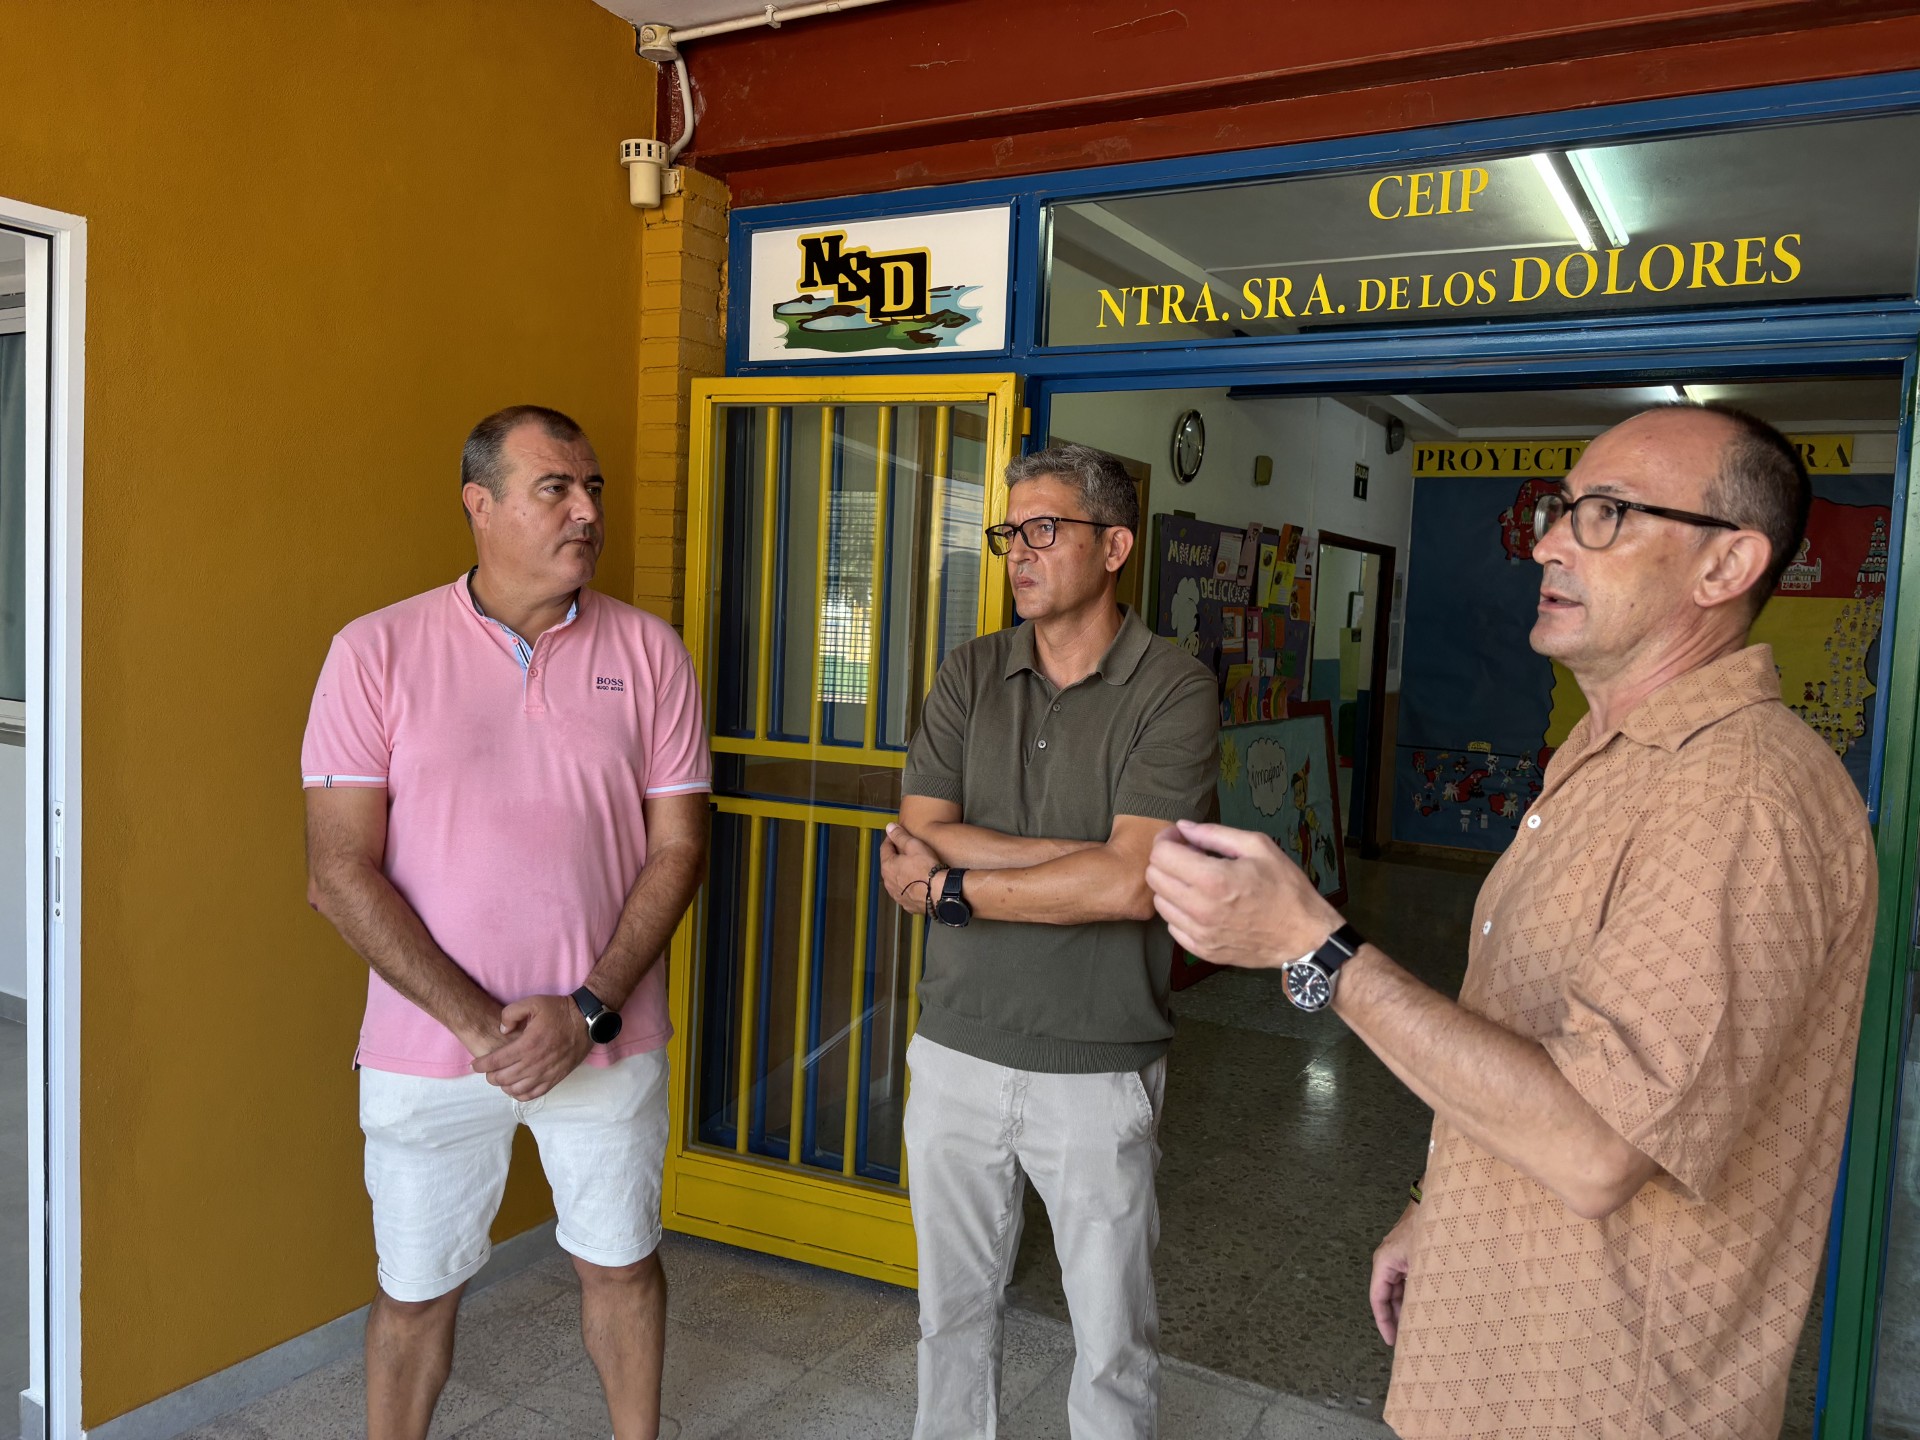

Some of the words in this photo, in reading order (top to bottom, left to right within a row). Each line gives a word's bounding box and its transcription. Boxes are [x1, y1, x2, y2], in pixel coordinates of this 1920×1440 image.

[1368, 167, 1490, 220] CEIP
[799, 232, 928, 320] NSD
[1097, 282, 1230, 328] NTRA.
[1241, 274, 1346, 320] SRA.
[1356, 275, 1411, 313] DE
[1418, 269, 1498, 309] LOS
[1508, 233, 1802, 302] DOLORES
[1416, 447, 1582, 471] PROYECT
[596, 676, 624, 686] BOSS
